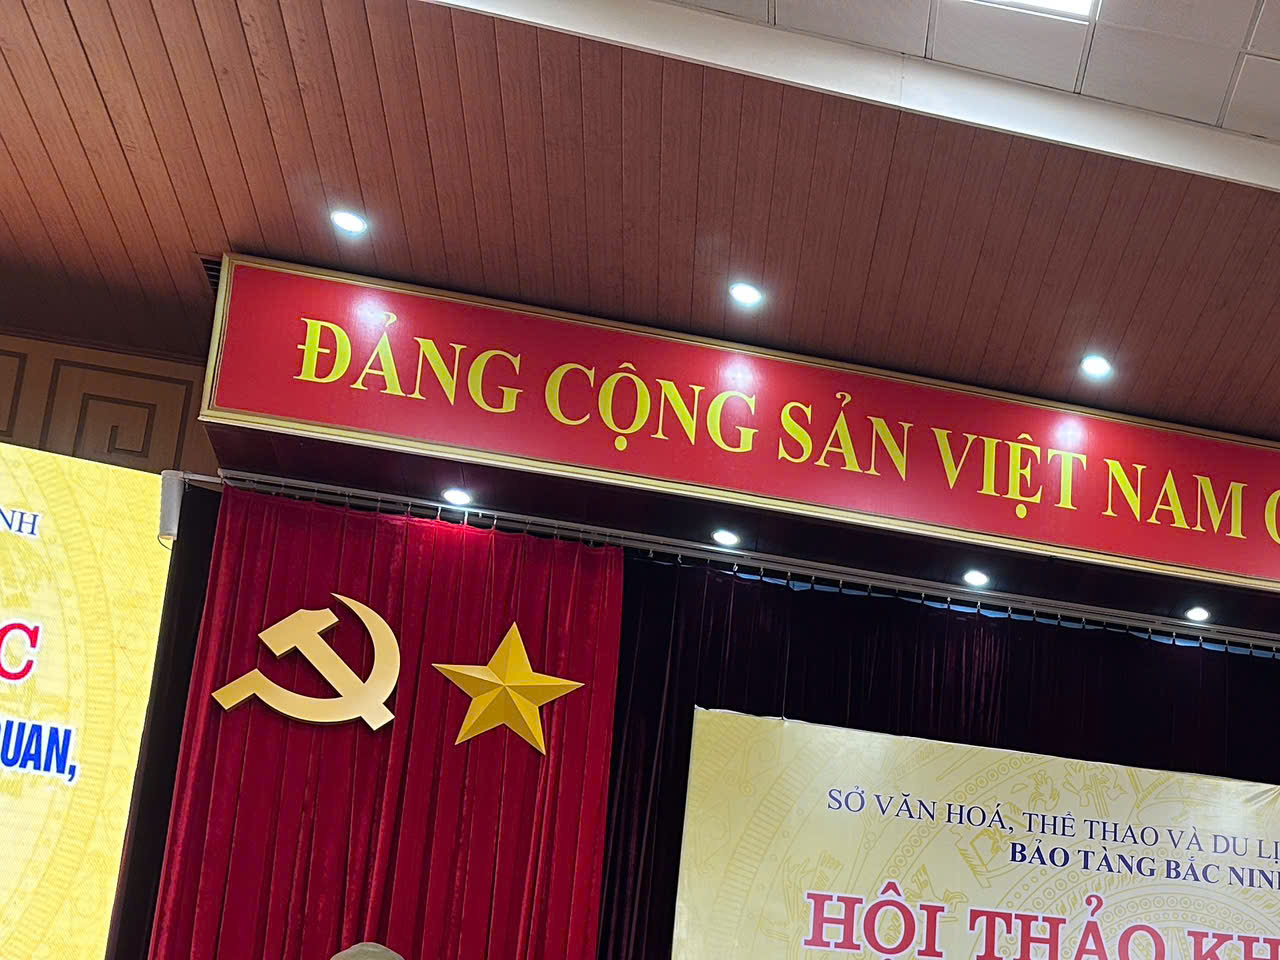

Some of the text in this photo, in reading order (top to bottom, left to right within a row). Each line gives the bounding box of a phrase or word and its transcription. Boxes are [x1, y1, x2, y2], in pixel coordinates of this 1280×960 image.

[295, 310, 523, 414] ĐẢNG
[544, 361, 759, 453] CỘNG
[778, 391, 913, 478] SẢN
[931, 426, 1088, 519] VIỆT
[1101, 458, 1247, 540] NAM
[0, 508, 38, 535] NH
[0, 719, 76, 782] UAN,
[827, 785, 865, 813] SỞ
[874, 792, 936, 821] VĂN
[945, 802, 1014, 834] HOÁ,
[1084, 818, 1160, 847] THAO
[1167, 826, 1203, 852] VÀ
[1212, 834, 1249, 857] DU
[1009, 838, 1070, 869] BẢO
[1077, 845, 1157, 879] TÀNG
[1165, 853, 1220, 885] BẮC
